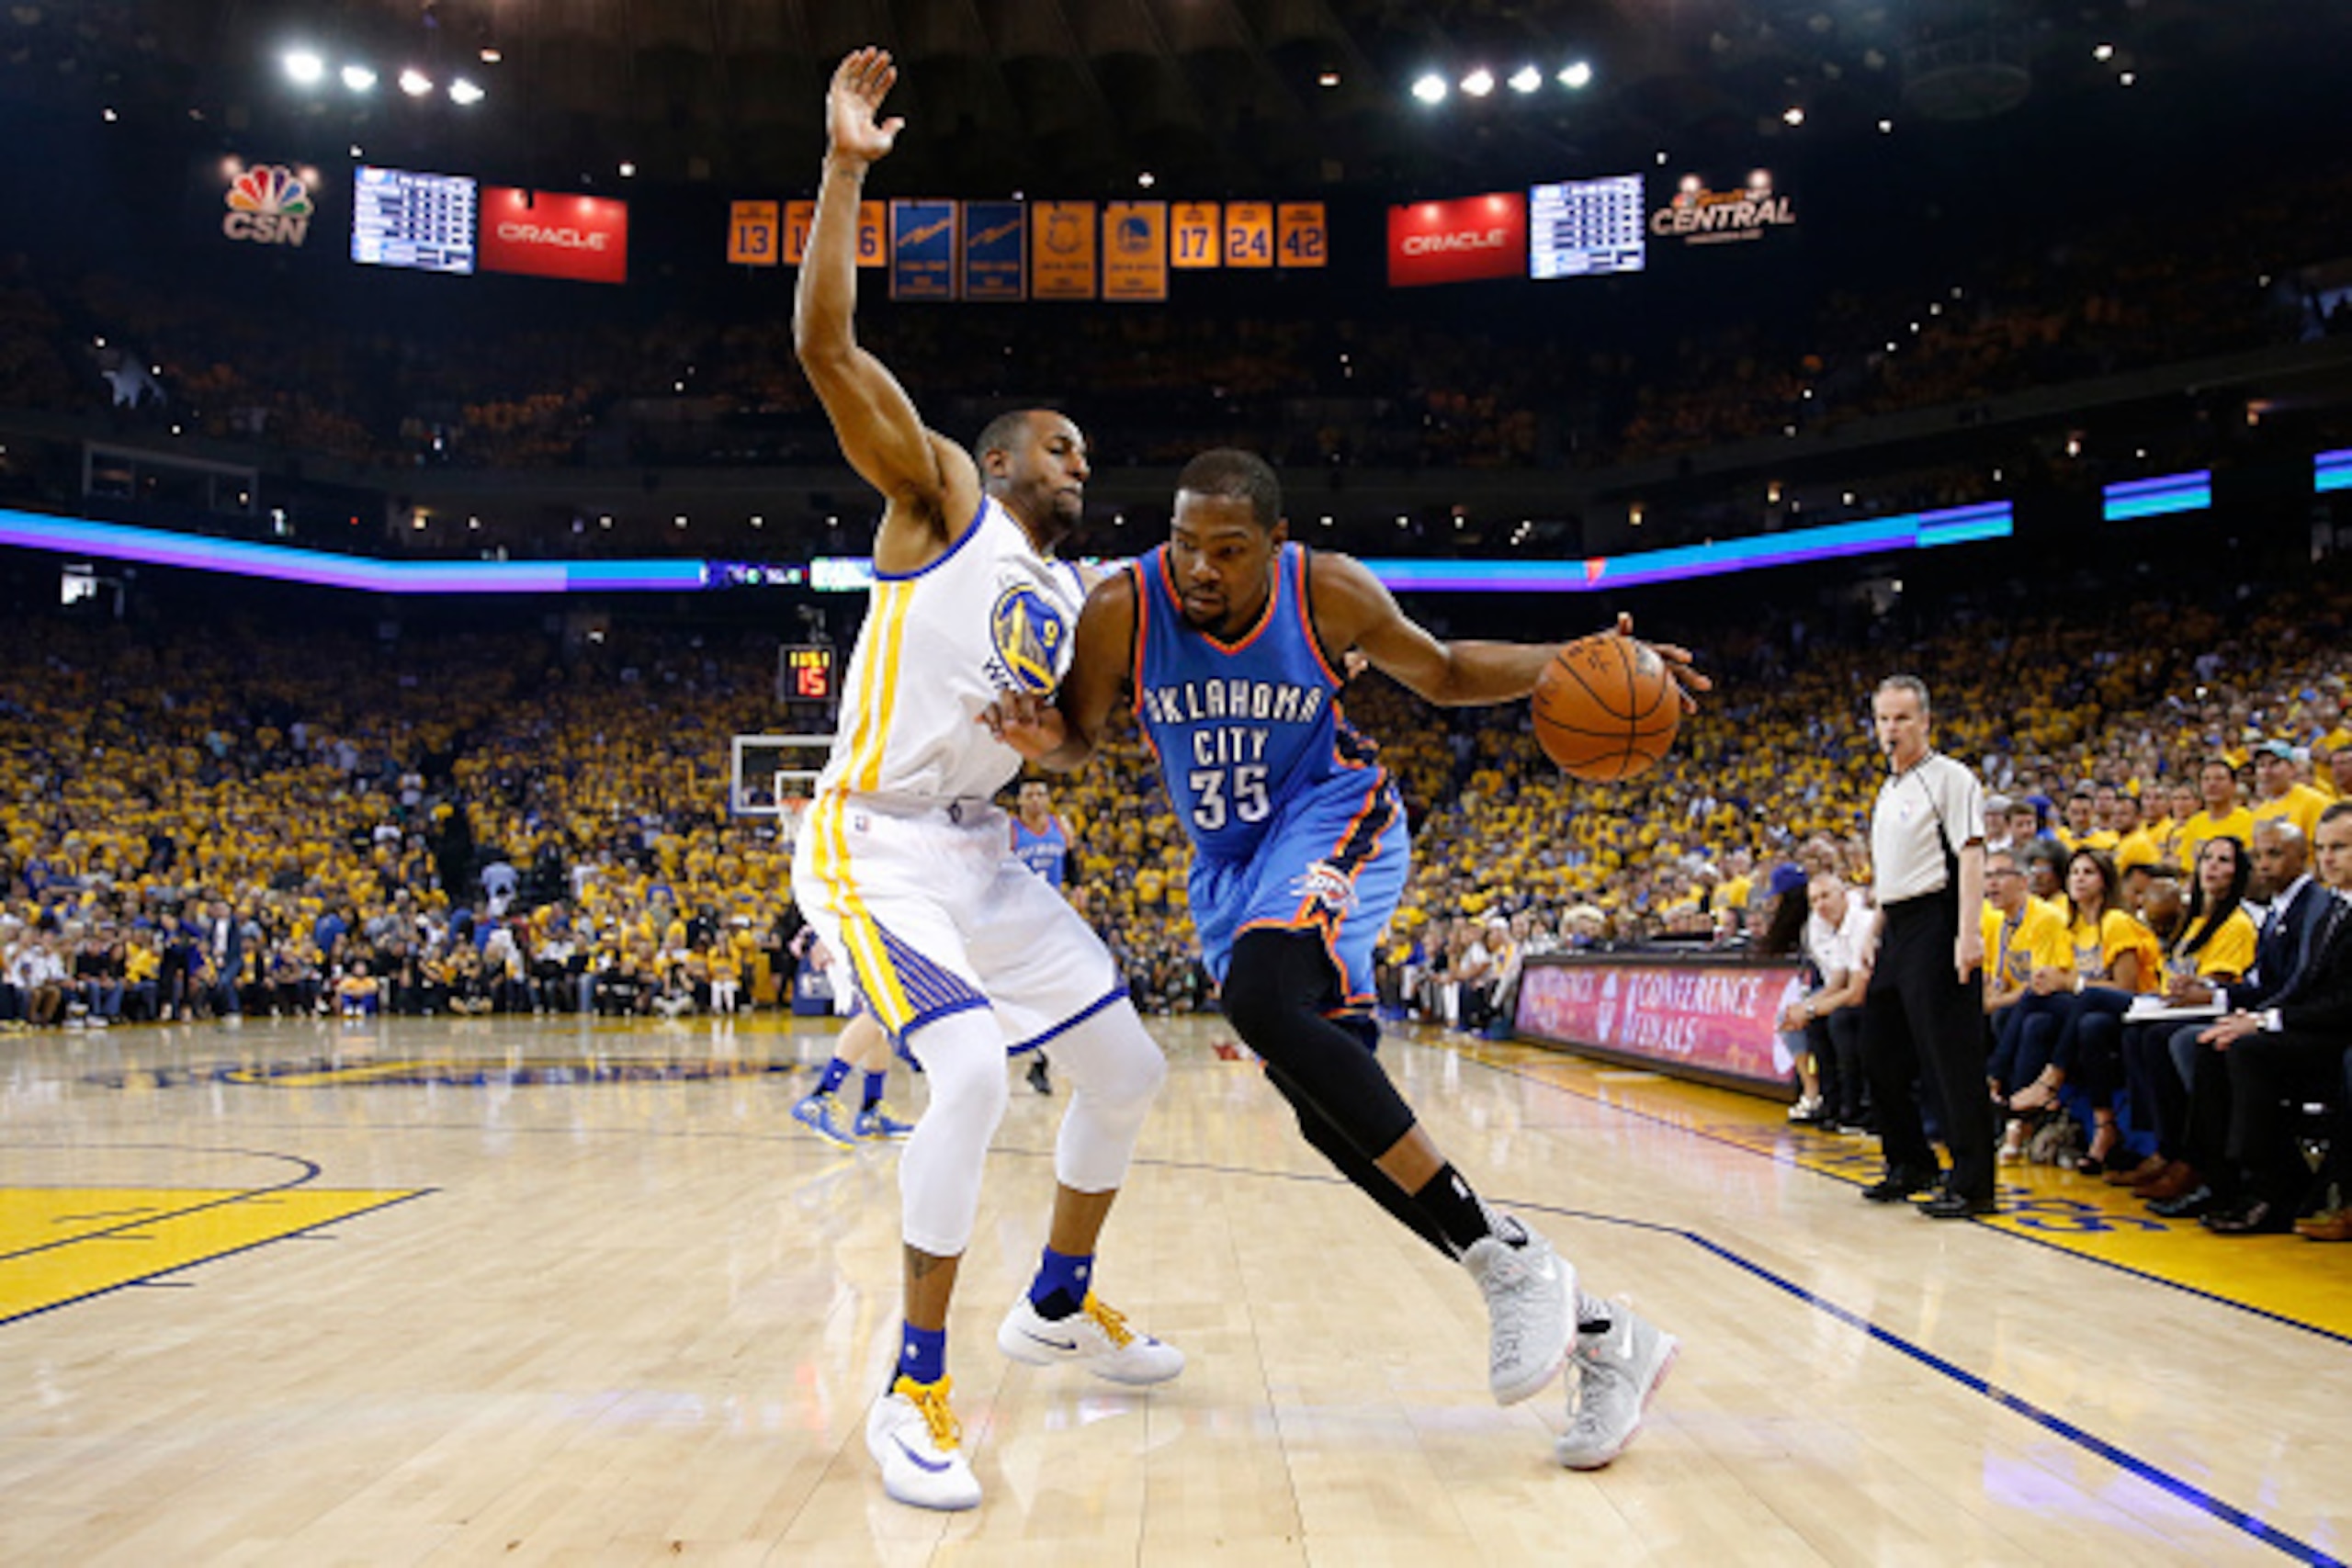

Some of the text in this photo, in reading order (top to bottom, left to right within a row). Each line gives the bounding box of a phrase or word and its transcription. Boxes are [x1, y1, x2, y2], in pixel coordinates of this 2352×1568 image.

[223, 210, 308, 246] CSN
[1651, 196, 1796, 236] CENTRAL
[497, 221, 609, 251] ORACLE
[739, 226, 769, 254] 13
[1180, 228, 1209, 258] 17
[1230, 228, 1268, 258] 24
[1286, 227, 1323, 257] 42
[1401, 228, 1508, 256] ORACLE
[797, 667, 827, 697] 15
[1193, 726, 1271, 766] CITY
[1188, 763, 1272, 830] 35
[1638, 972, 1764, 1020] CONFERENCE
